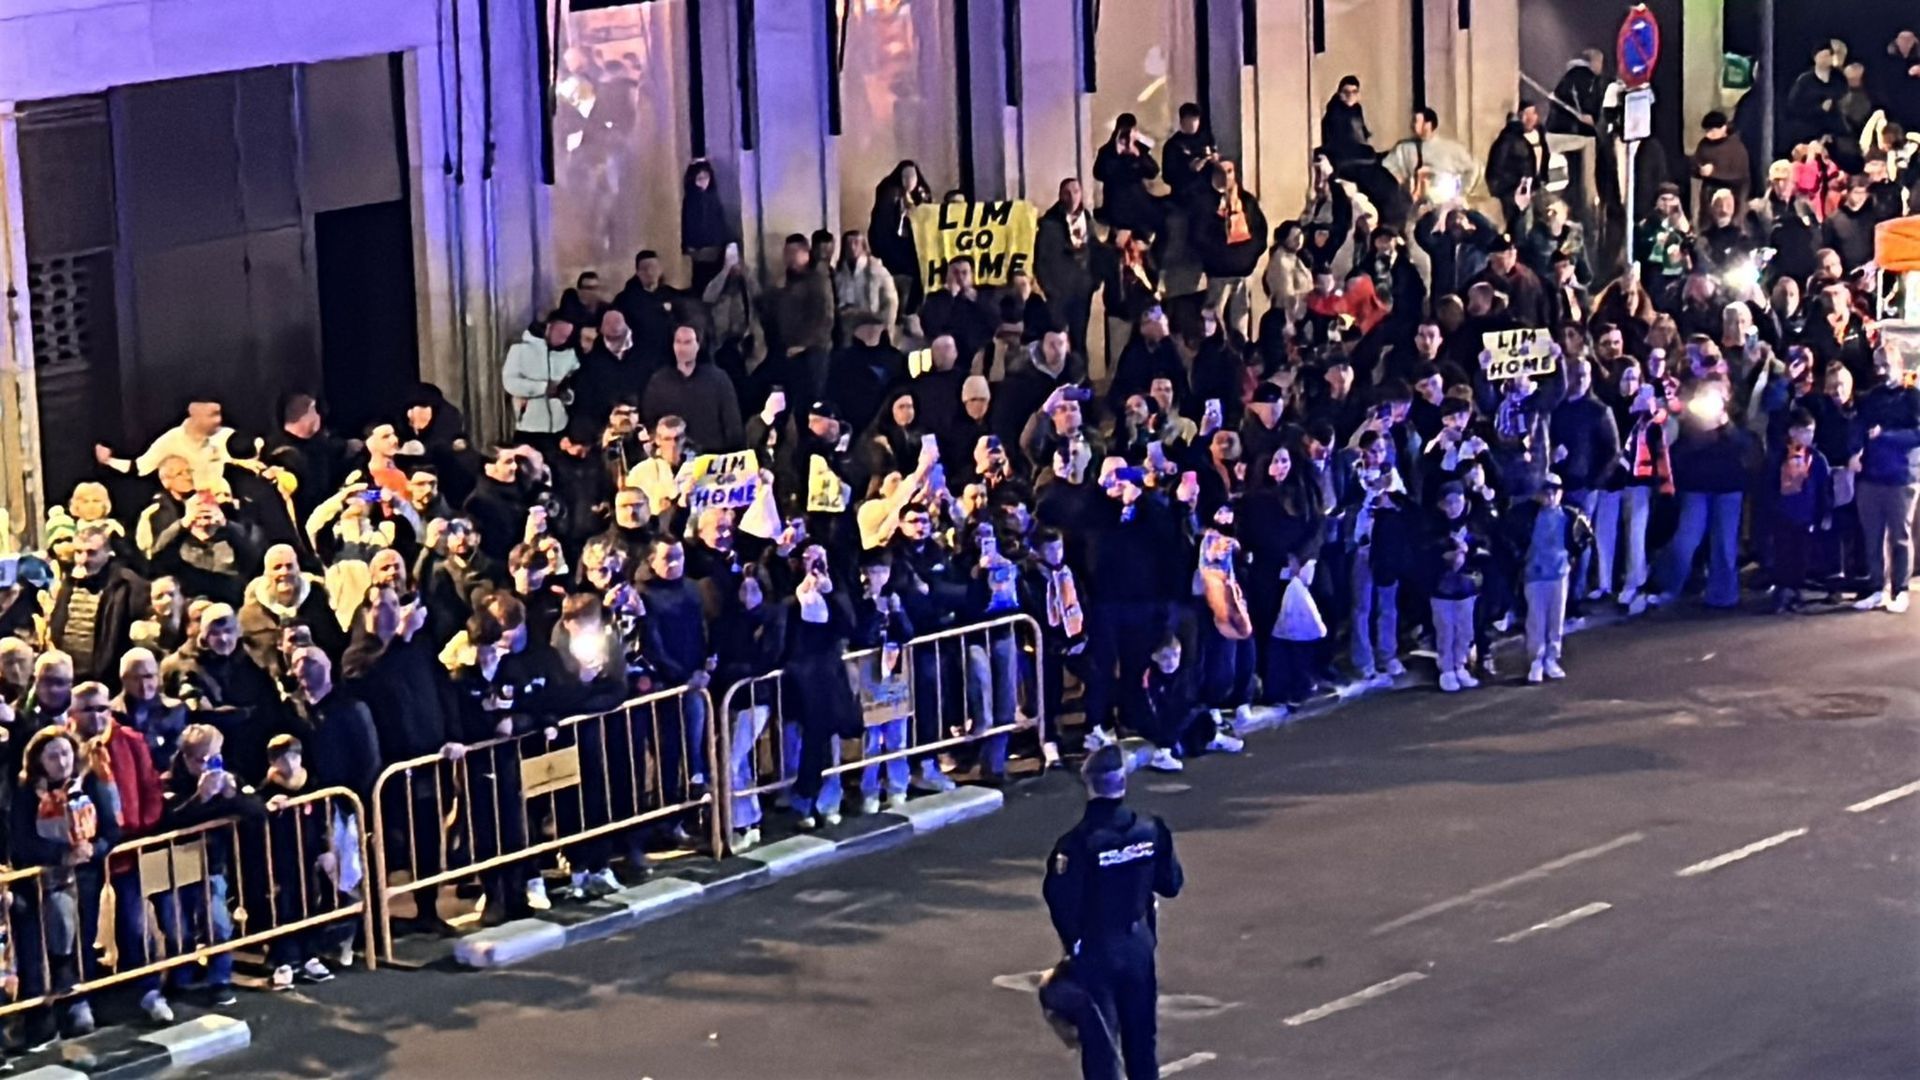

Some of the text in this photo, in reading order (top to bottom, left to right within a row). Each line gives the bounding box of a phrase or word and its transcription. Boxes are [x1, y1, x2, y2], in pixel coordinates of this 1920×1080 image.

[938, 201, 1014, 231] LIM
[955, 229, 994, 252] GO
[1498, 330, 1537, 349] LIM
[1490, 356, 1551, 377] HOME
[706, 455, 746, 475] LIM
[695, 484, 757, 507] HOME
